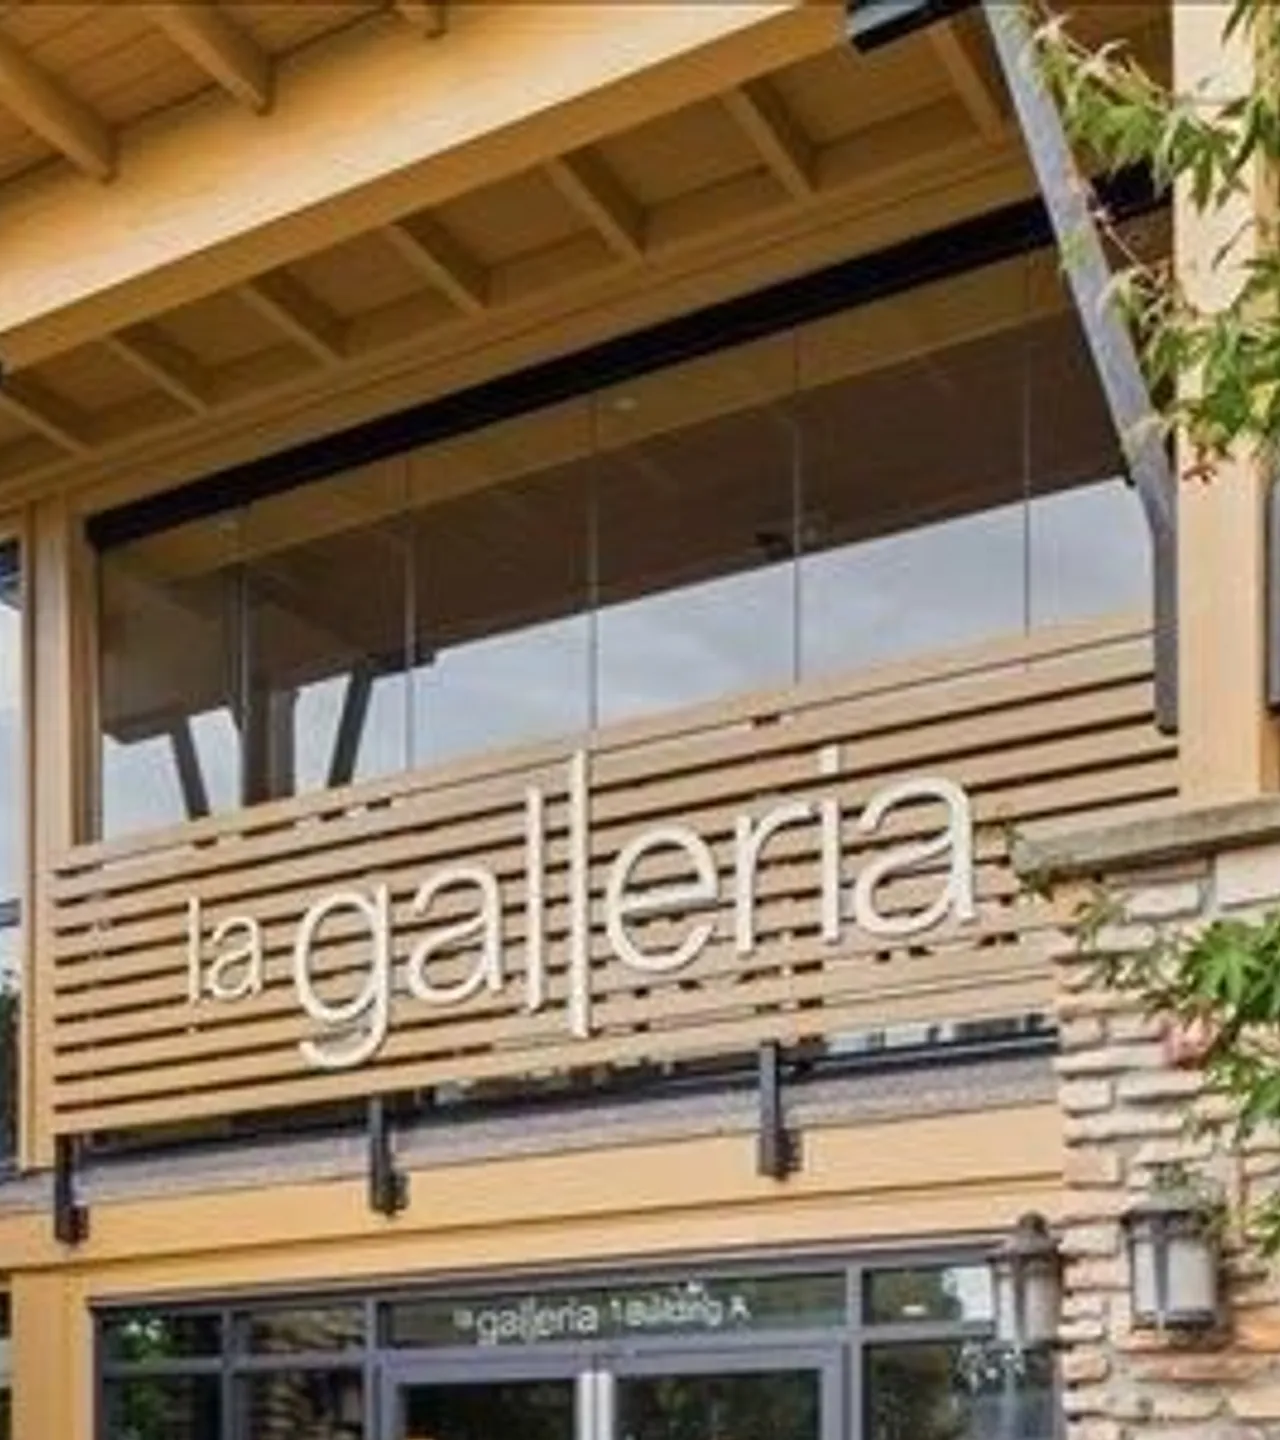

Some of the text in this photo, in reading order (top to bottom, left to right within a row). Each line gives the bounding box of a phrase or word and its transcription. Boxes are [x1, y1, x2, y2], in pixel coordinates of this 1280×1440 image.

[186, 743, 979, 1072] la galleria
[475, 1296, 599, 1347] galleria
